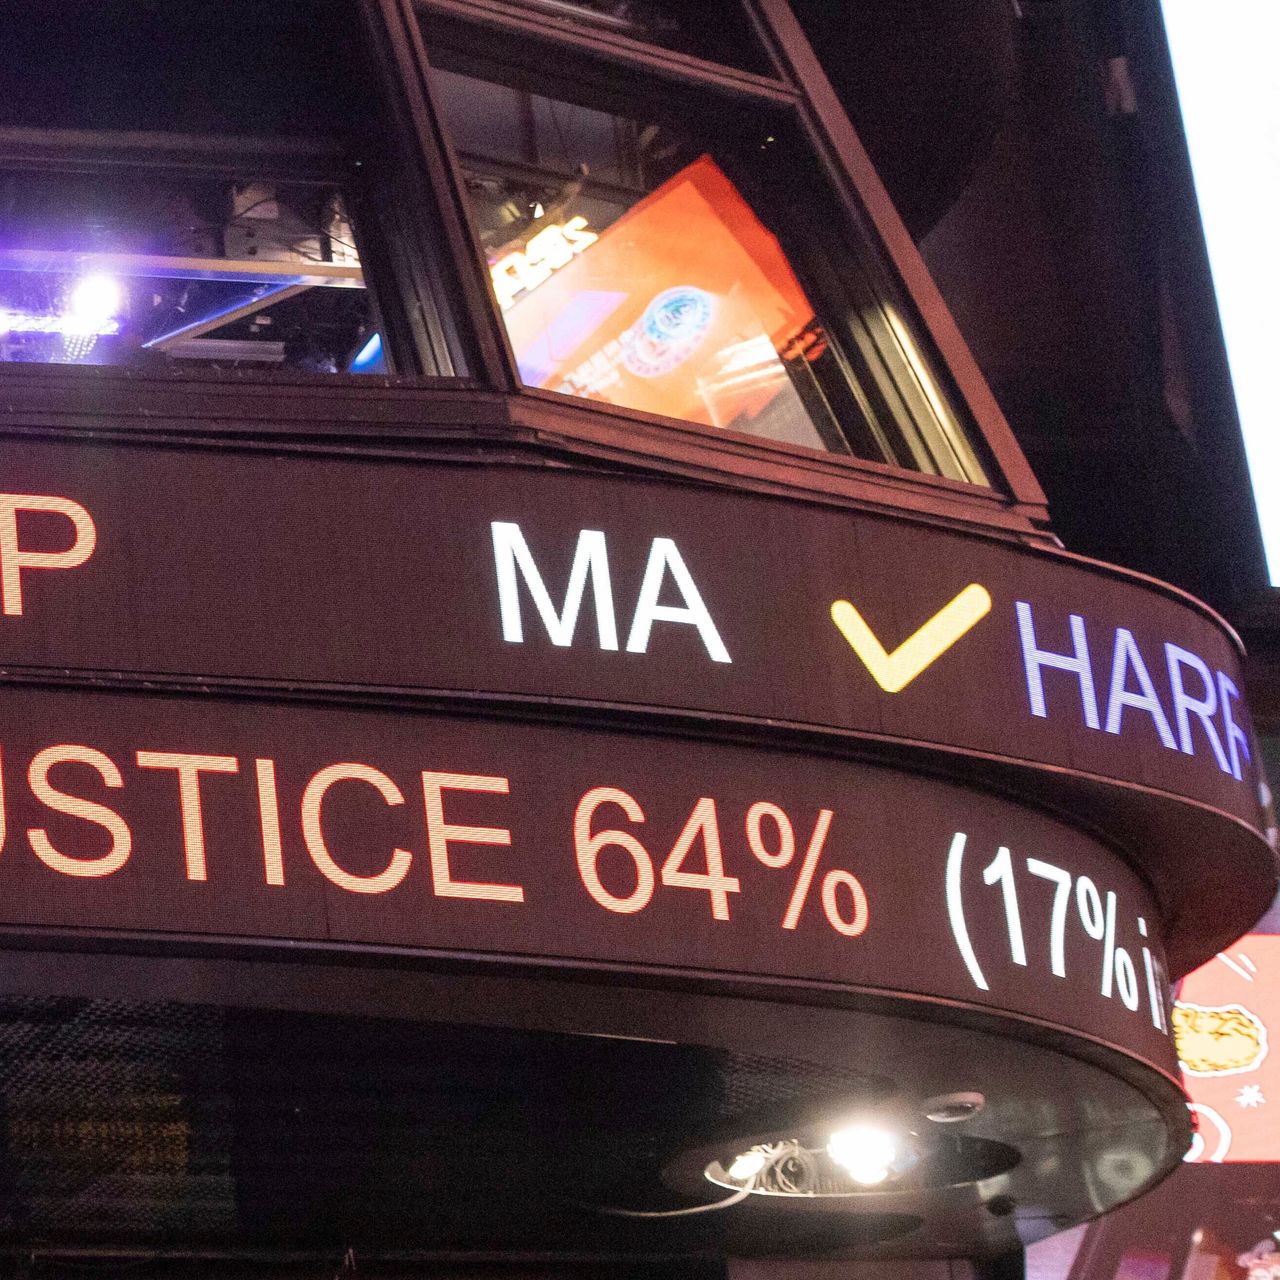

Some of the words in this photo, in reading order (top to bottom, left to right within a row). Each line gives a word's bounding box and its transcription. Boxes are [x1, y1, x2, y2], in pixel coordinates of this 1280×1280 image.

[491, 521, 732, 663] MA
[572, 787, 871, 937] 64%
[946, 832, 1139, 1012] (17%
